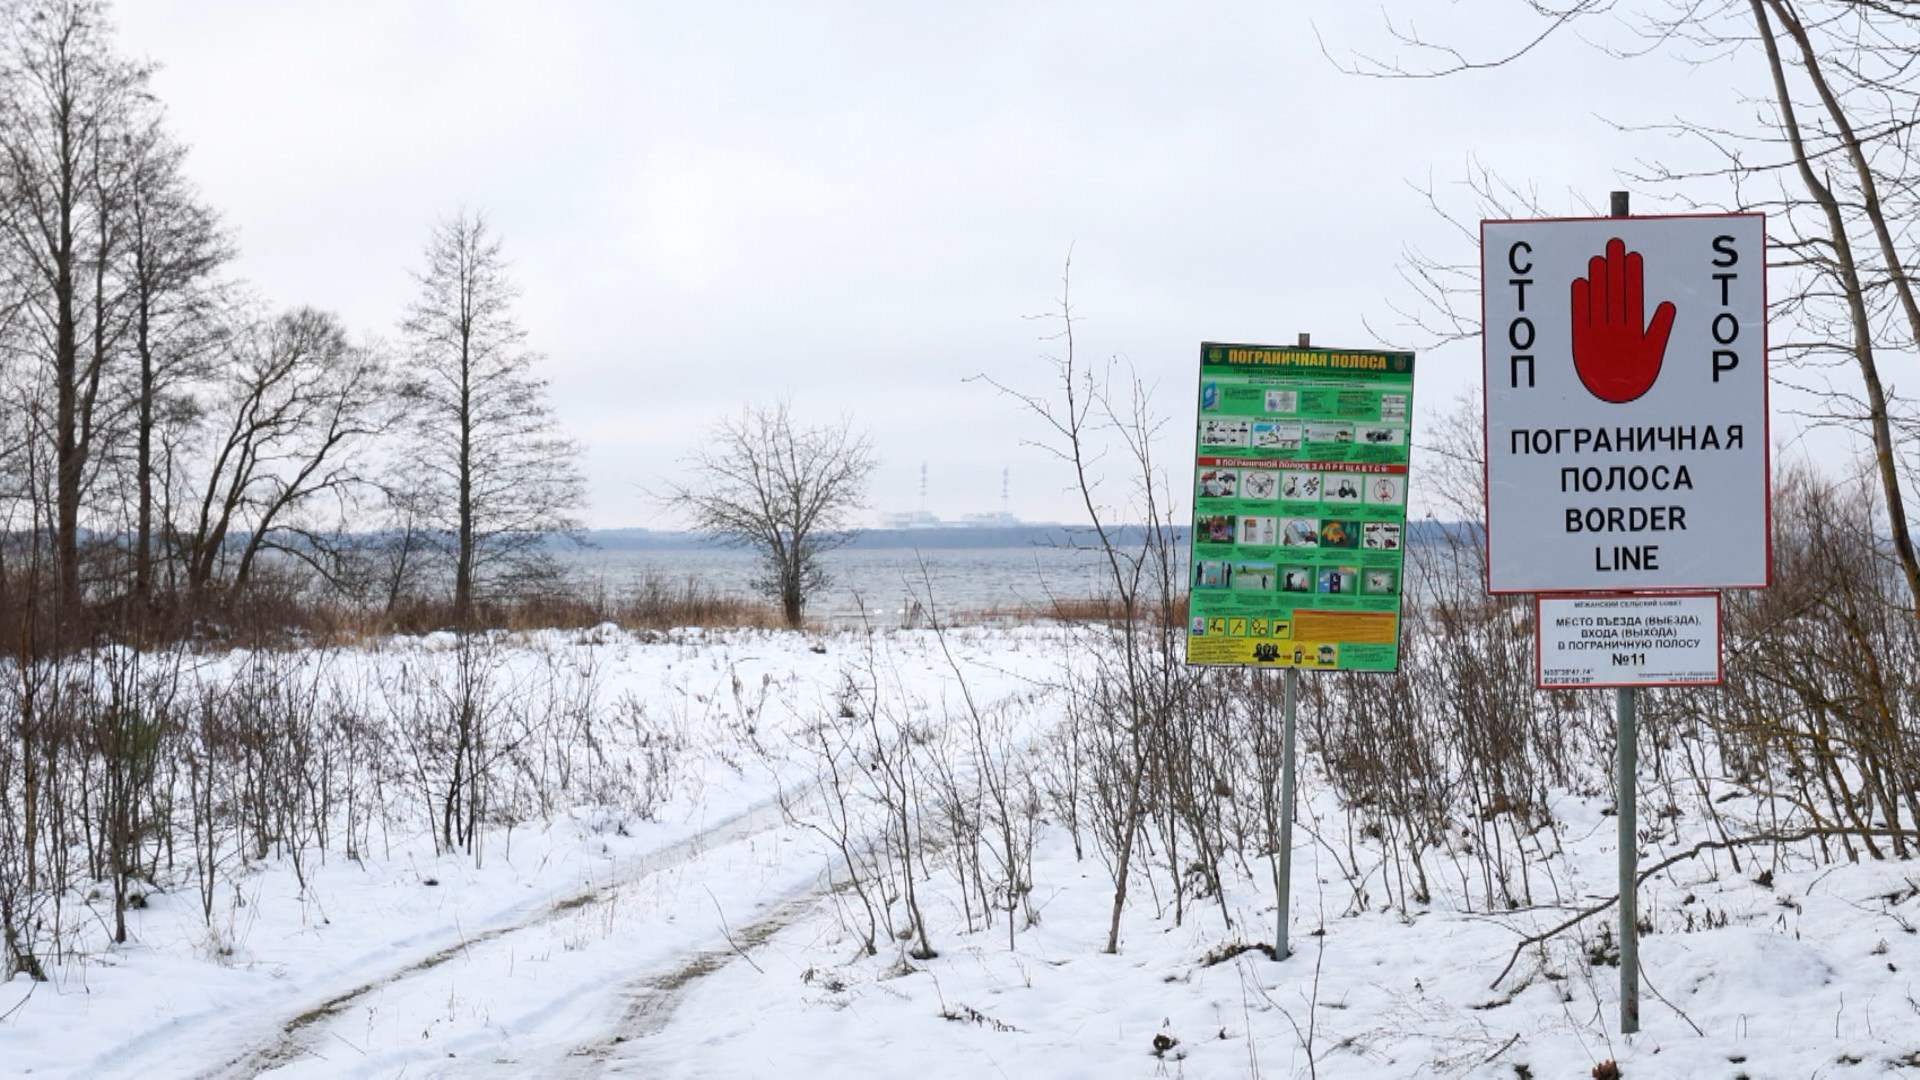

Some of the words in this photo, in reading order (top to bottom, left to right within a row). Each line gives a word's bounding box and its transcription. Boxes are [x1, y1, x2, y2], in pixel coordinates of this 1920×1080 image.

[1508, 240, 1536, 388] СТОП
[1711, 235, 1739, 383] STOP
[1228, 349, 1327, 366] ПОГРАНИЧНАЯ
[1331, 354, 1387, 369] ПОЛОСА
[1510, 424, 1744, 455] ПОГРАНИЧНАЯ
[1222, 459, 1278, 468] ПОГРАНИЧНОЙ
[1561, 464, 1693, 492] ПОЛОСА
[1565, 506, 1687, 533] BORDER
[1595, 545, 1659, 572] LINE
[1556, 616, 1593, 627] МЕСТО
[1597, 616, 1642, 626] ВЪЕЗДА
[1581, 628, 1618, 639] ВХОДА
[1621, 627, 1677, 639] (ВЫХОДА)
[1557, 641, 1565, 650] В
[1568, 640, 1652, 651] ПОГРАНИЧНУЮ
[1655, 639, 1701, 649] ПОЛОСУ
[1612, 652, 1646, 666] №11
